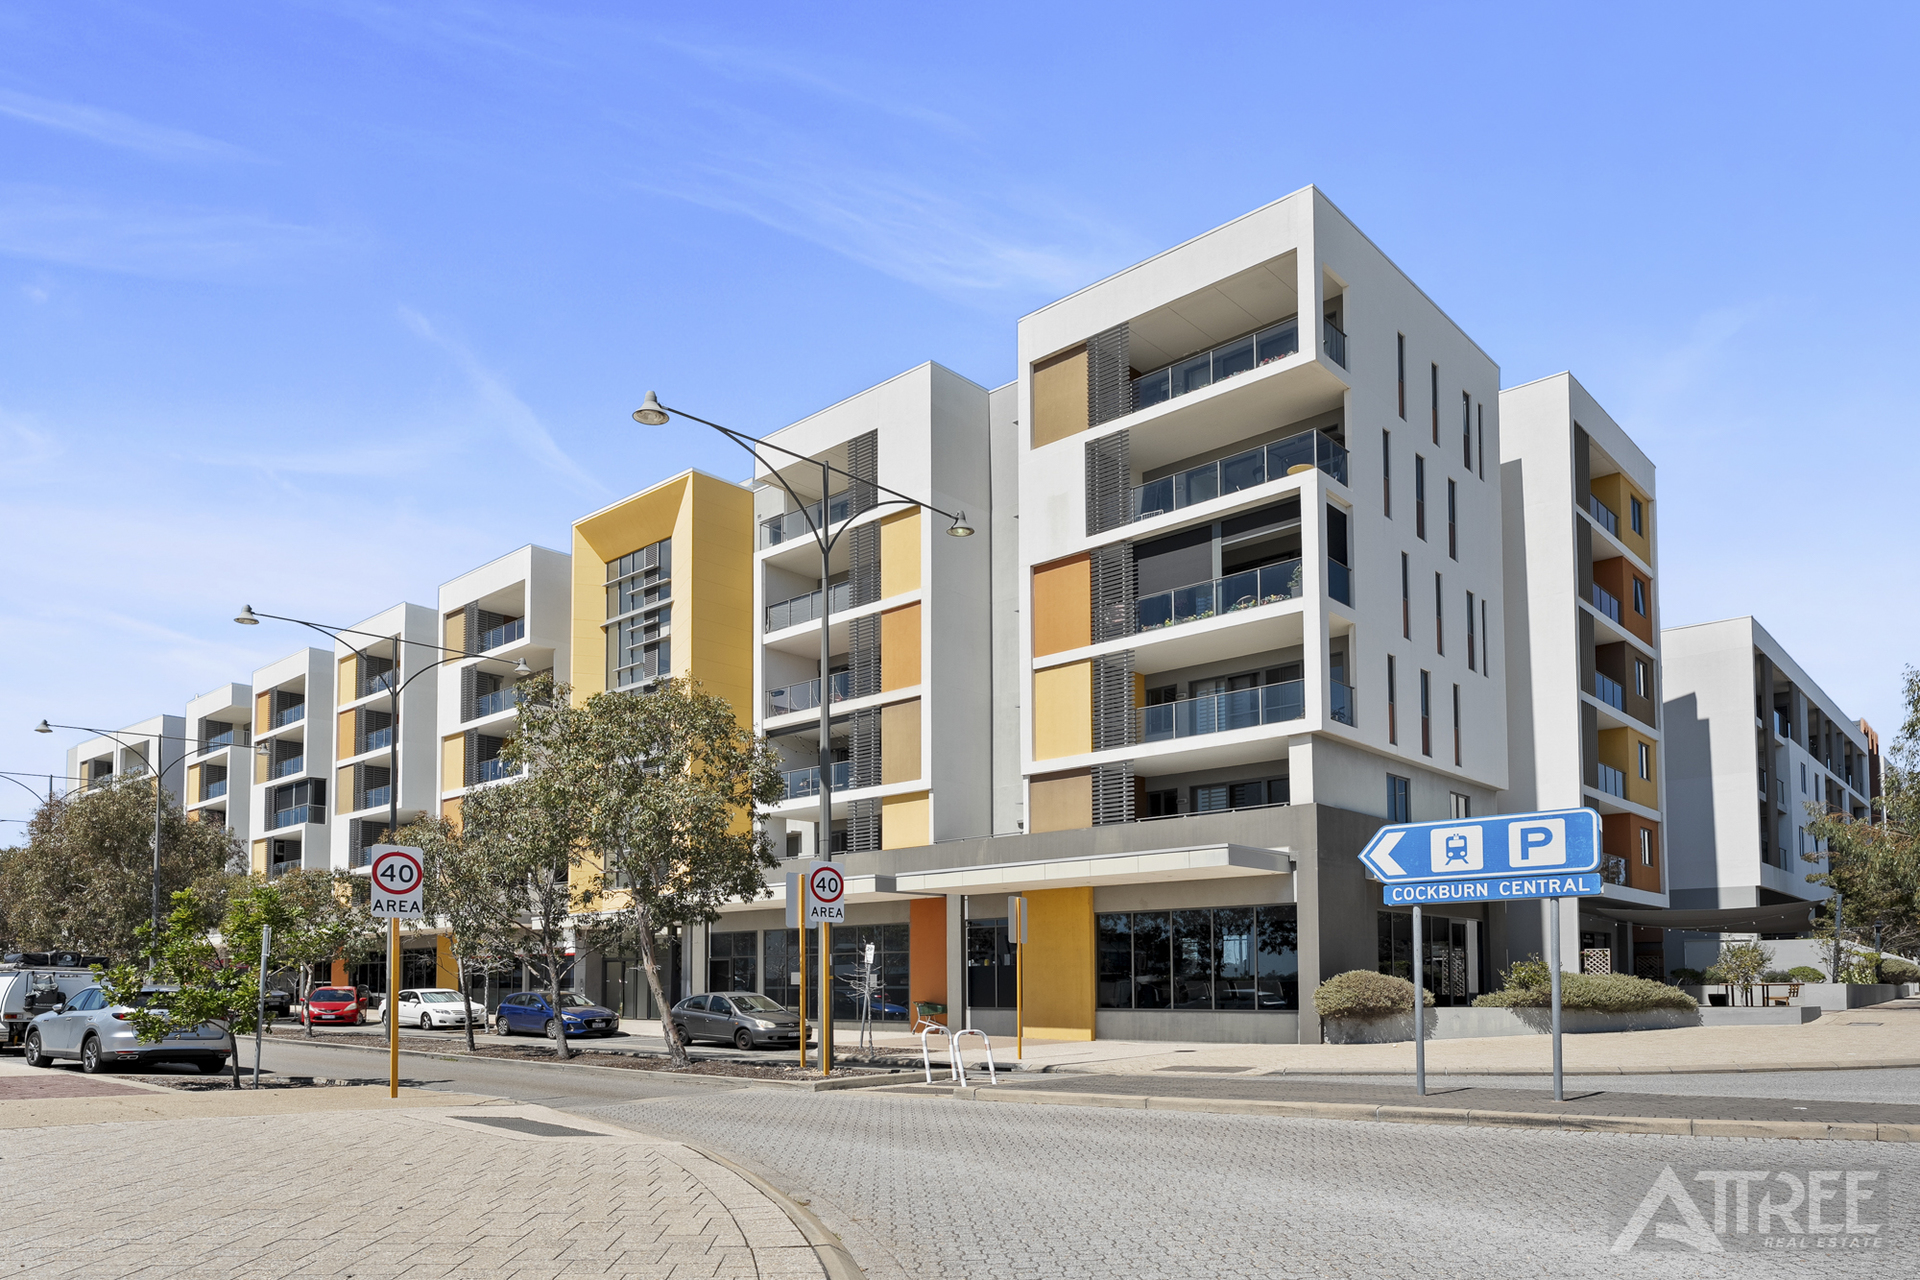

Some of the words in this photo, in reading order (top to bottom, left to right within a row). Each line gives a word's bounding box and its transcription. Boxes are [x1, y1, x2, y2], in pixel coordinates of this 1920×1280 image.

[1520, 826, 1553, 861] P
[380, 864, 414, 883] 40
[816, 877, 838, 893] 40
[1392, 883, 1488, 901] COCKBURN
[1499, 877, 1590, 896] CENTRAL
[373, 899, 421, 913] AREA
[811, 906, 843, 918] AREA
